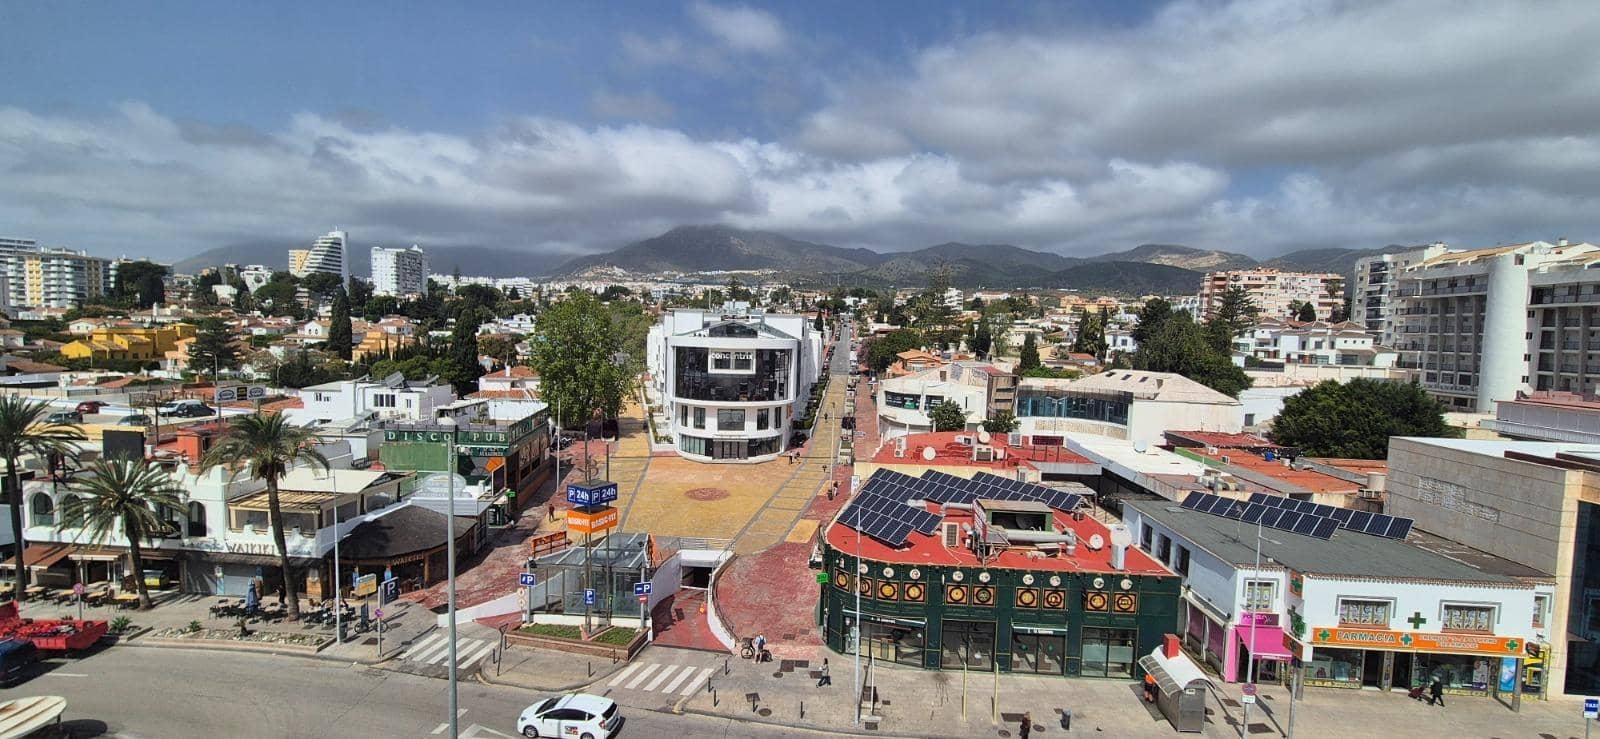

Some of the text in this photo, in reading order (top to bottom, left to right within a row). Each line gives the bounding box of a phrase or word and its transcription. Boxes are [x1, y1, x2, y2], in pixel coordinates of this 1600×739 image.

[388, 431, 506, 442] DISCO PUB
[576, 490, 589, 500] 24h
[601, 488, 616, 498] 24h
[1336, 631, 1396, 643] FARMACIA
